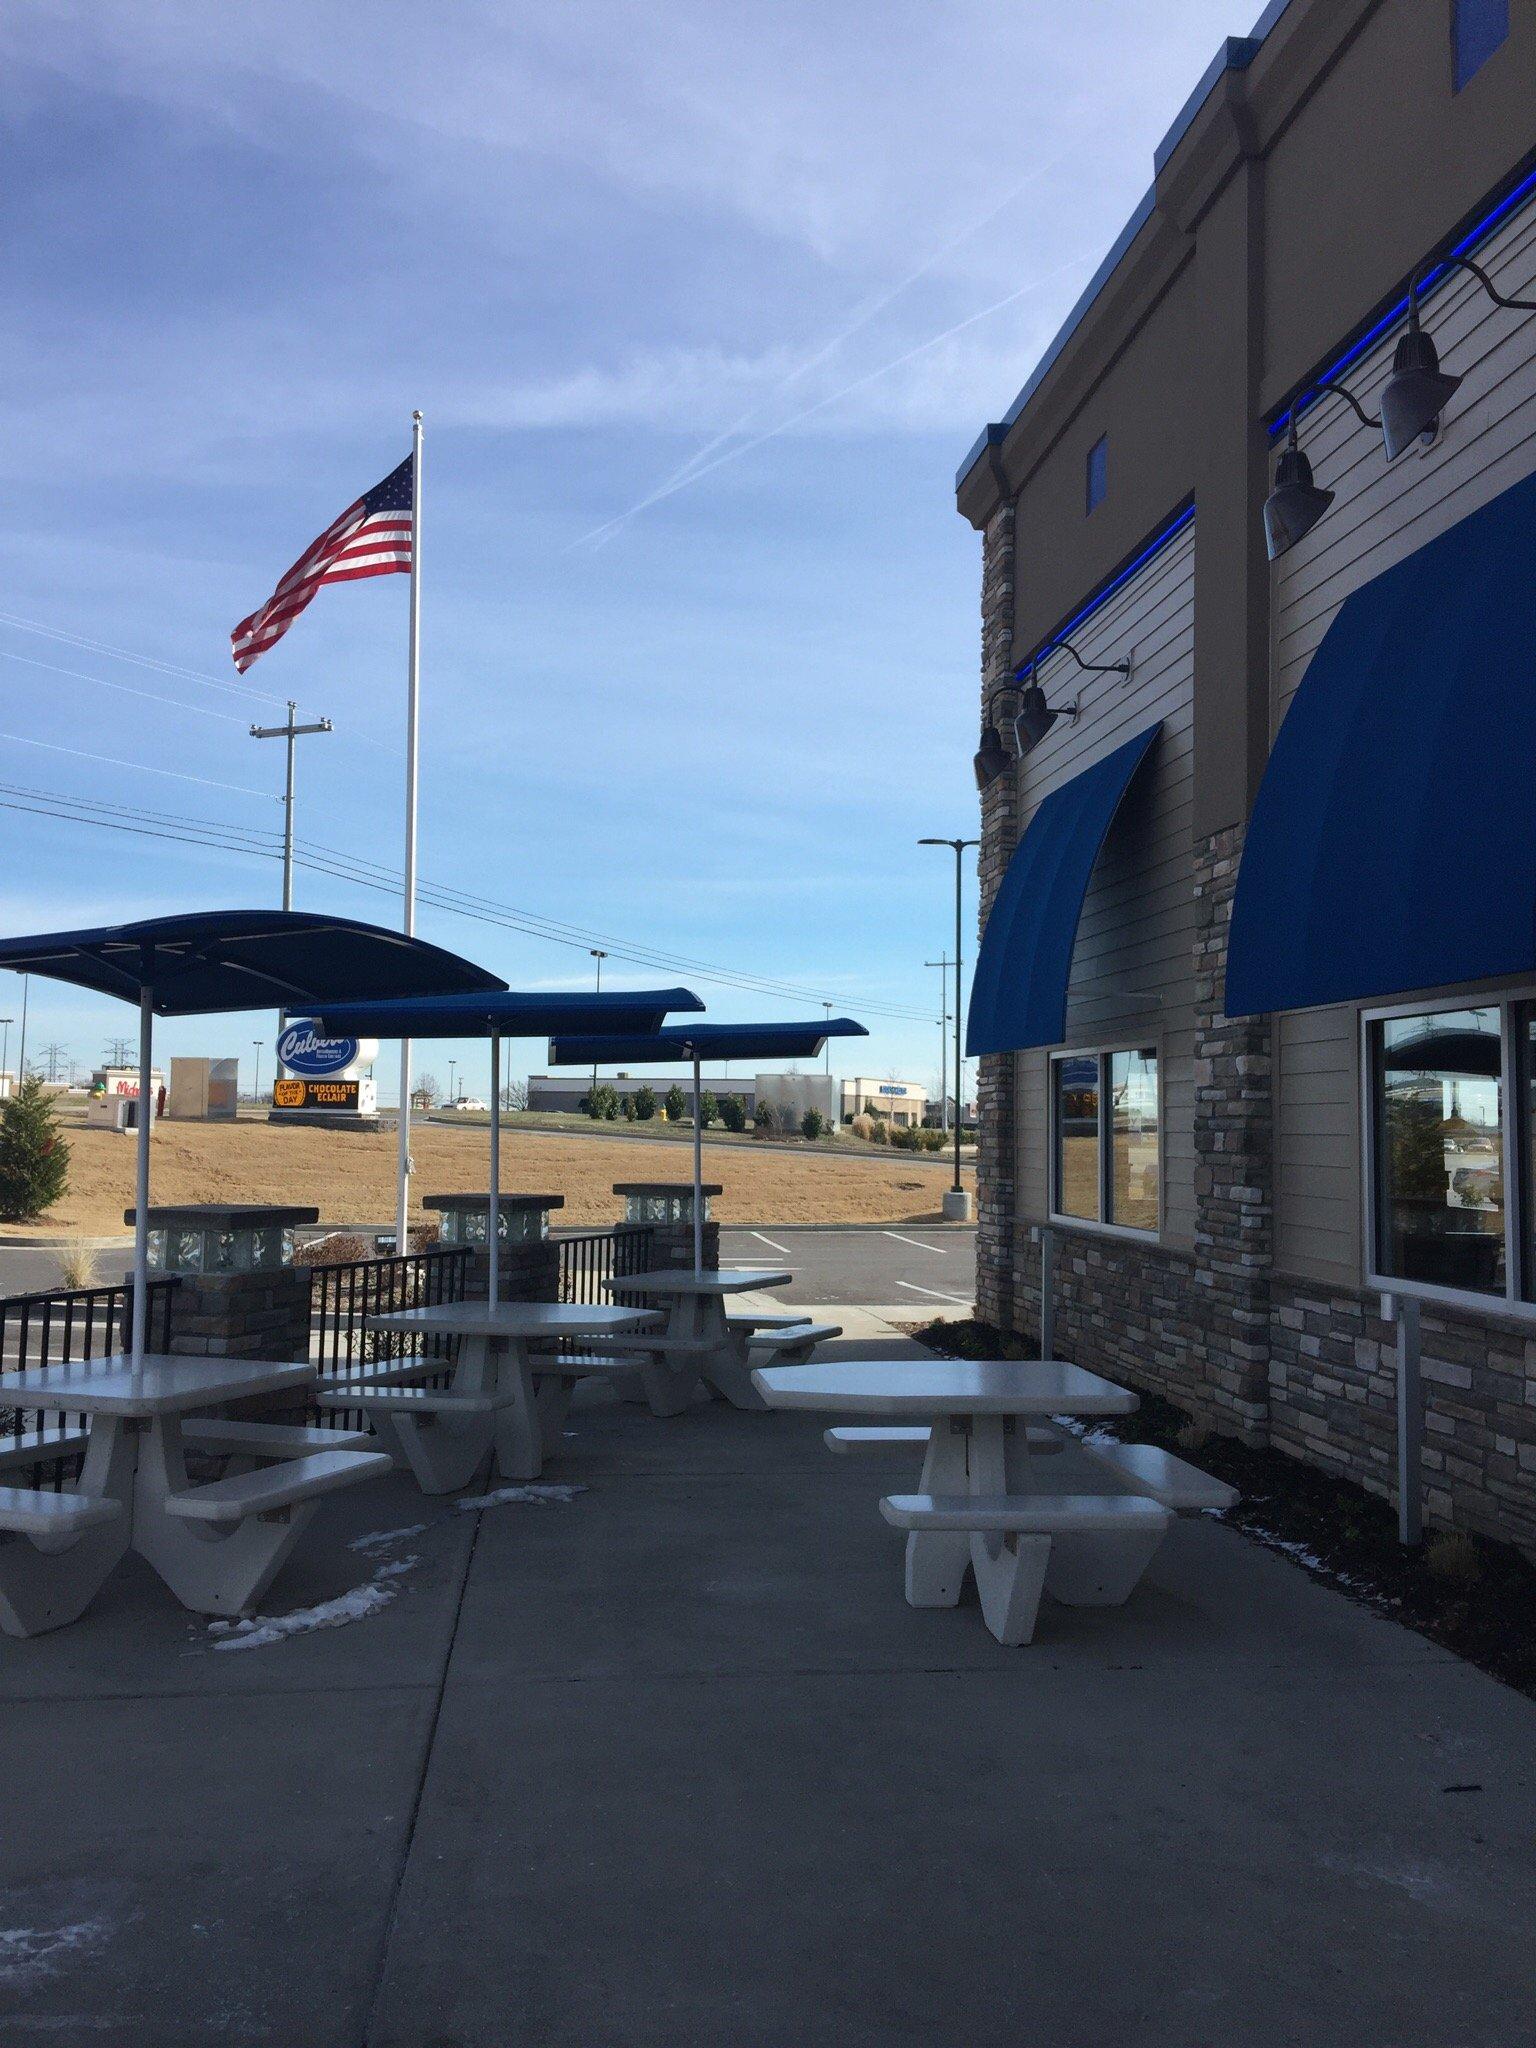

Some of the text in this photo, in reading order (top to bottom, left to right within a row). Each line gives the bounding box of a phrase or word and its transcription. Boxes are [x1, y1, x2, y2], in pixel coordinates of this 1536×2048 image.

[280, 1031, 345, 1061] Culver
[279, 1082, 300, 1091] FLAVOR
[308, 1084, 357, 1094] CHOCOLATE
[283, 1096, 298, 1104] DAY
[317, 1093, 347, 1102] ECLAIR
